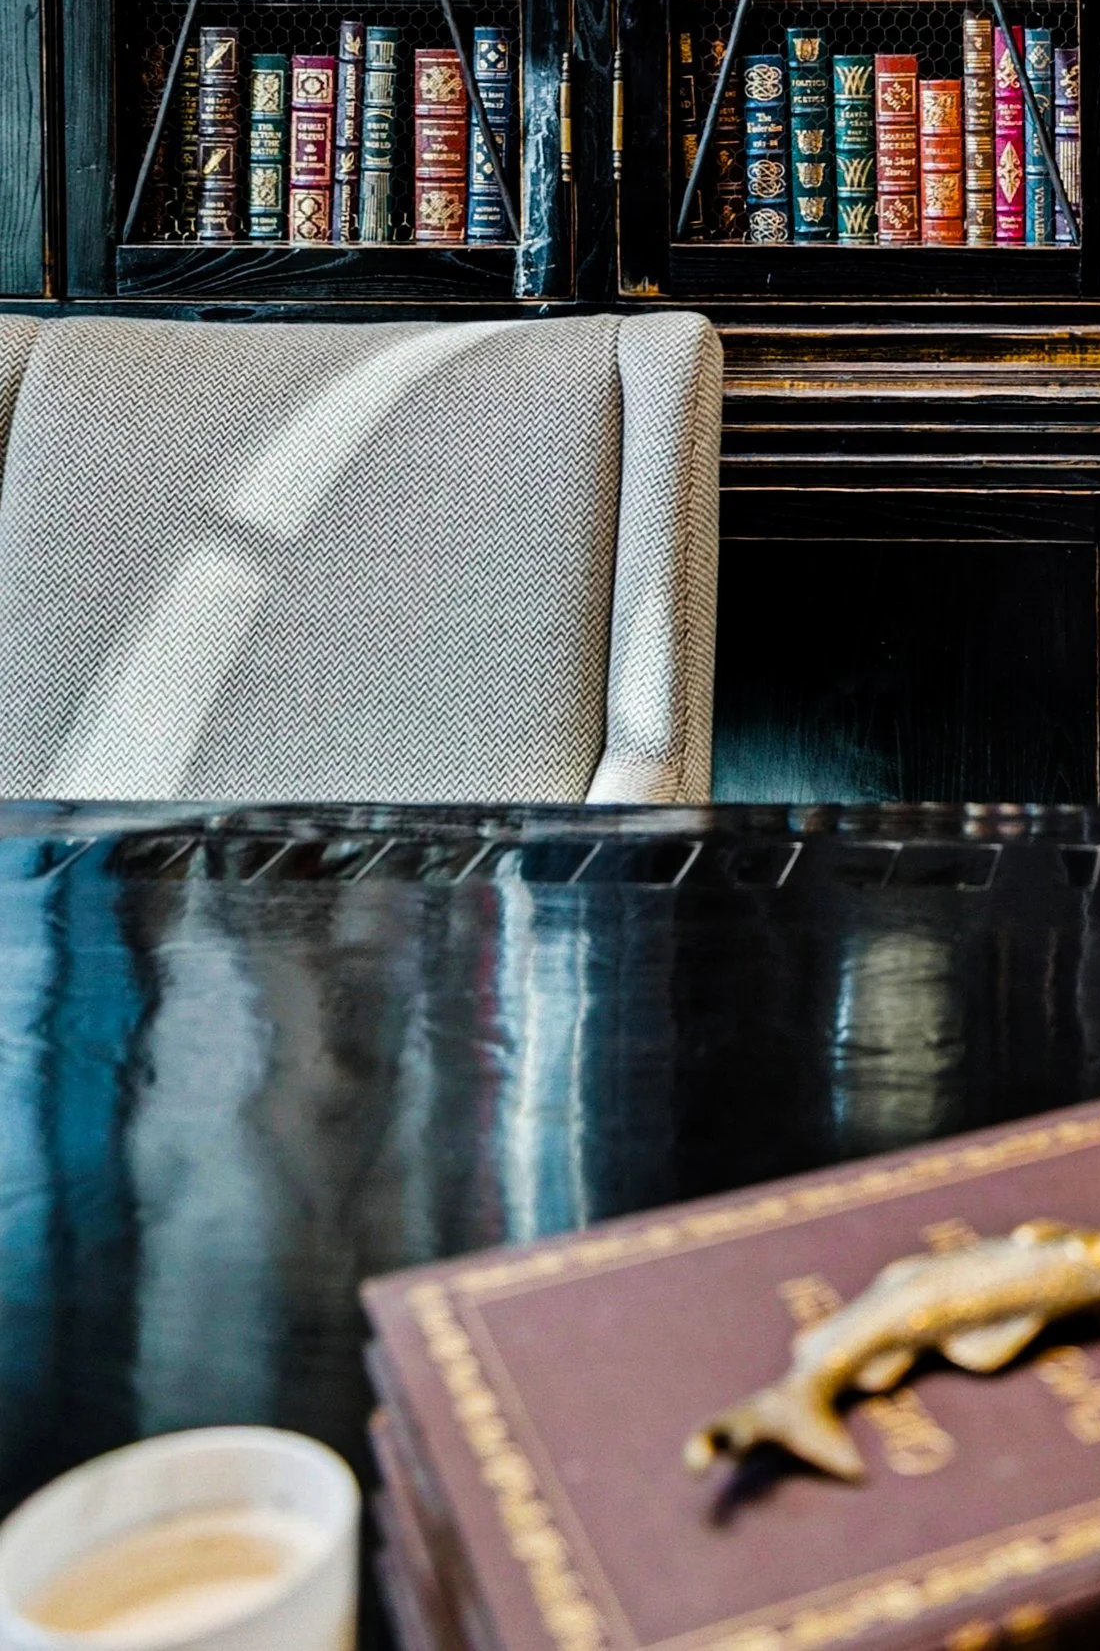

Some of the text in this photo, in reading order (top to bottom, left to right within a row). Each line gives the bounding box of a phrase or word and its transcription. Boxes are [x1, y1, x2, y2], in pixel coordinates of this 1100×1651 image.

[791, 79, 826, 87] POLITICS
[345, 100, 355, 118] THE
[756, 112, 772, 122] The
[344, 118, 354, 140] KING
[880, 132, 916, 141] CHARLES
[880, 141, 916, 150] DICKENS
[880, 156, 916, 166] The Short
[884, 167, 912, 177] Stories
